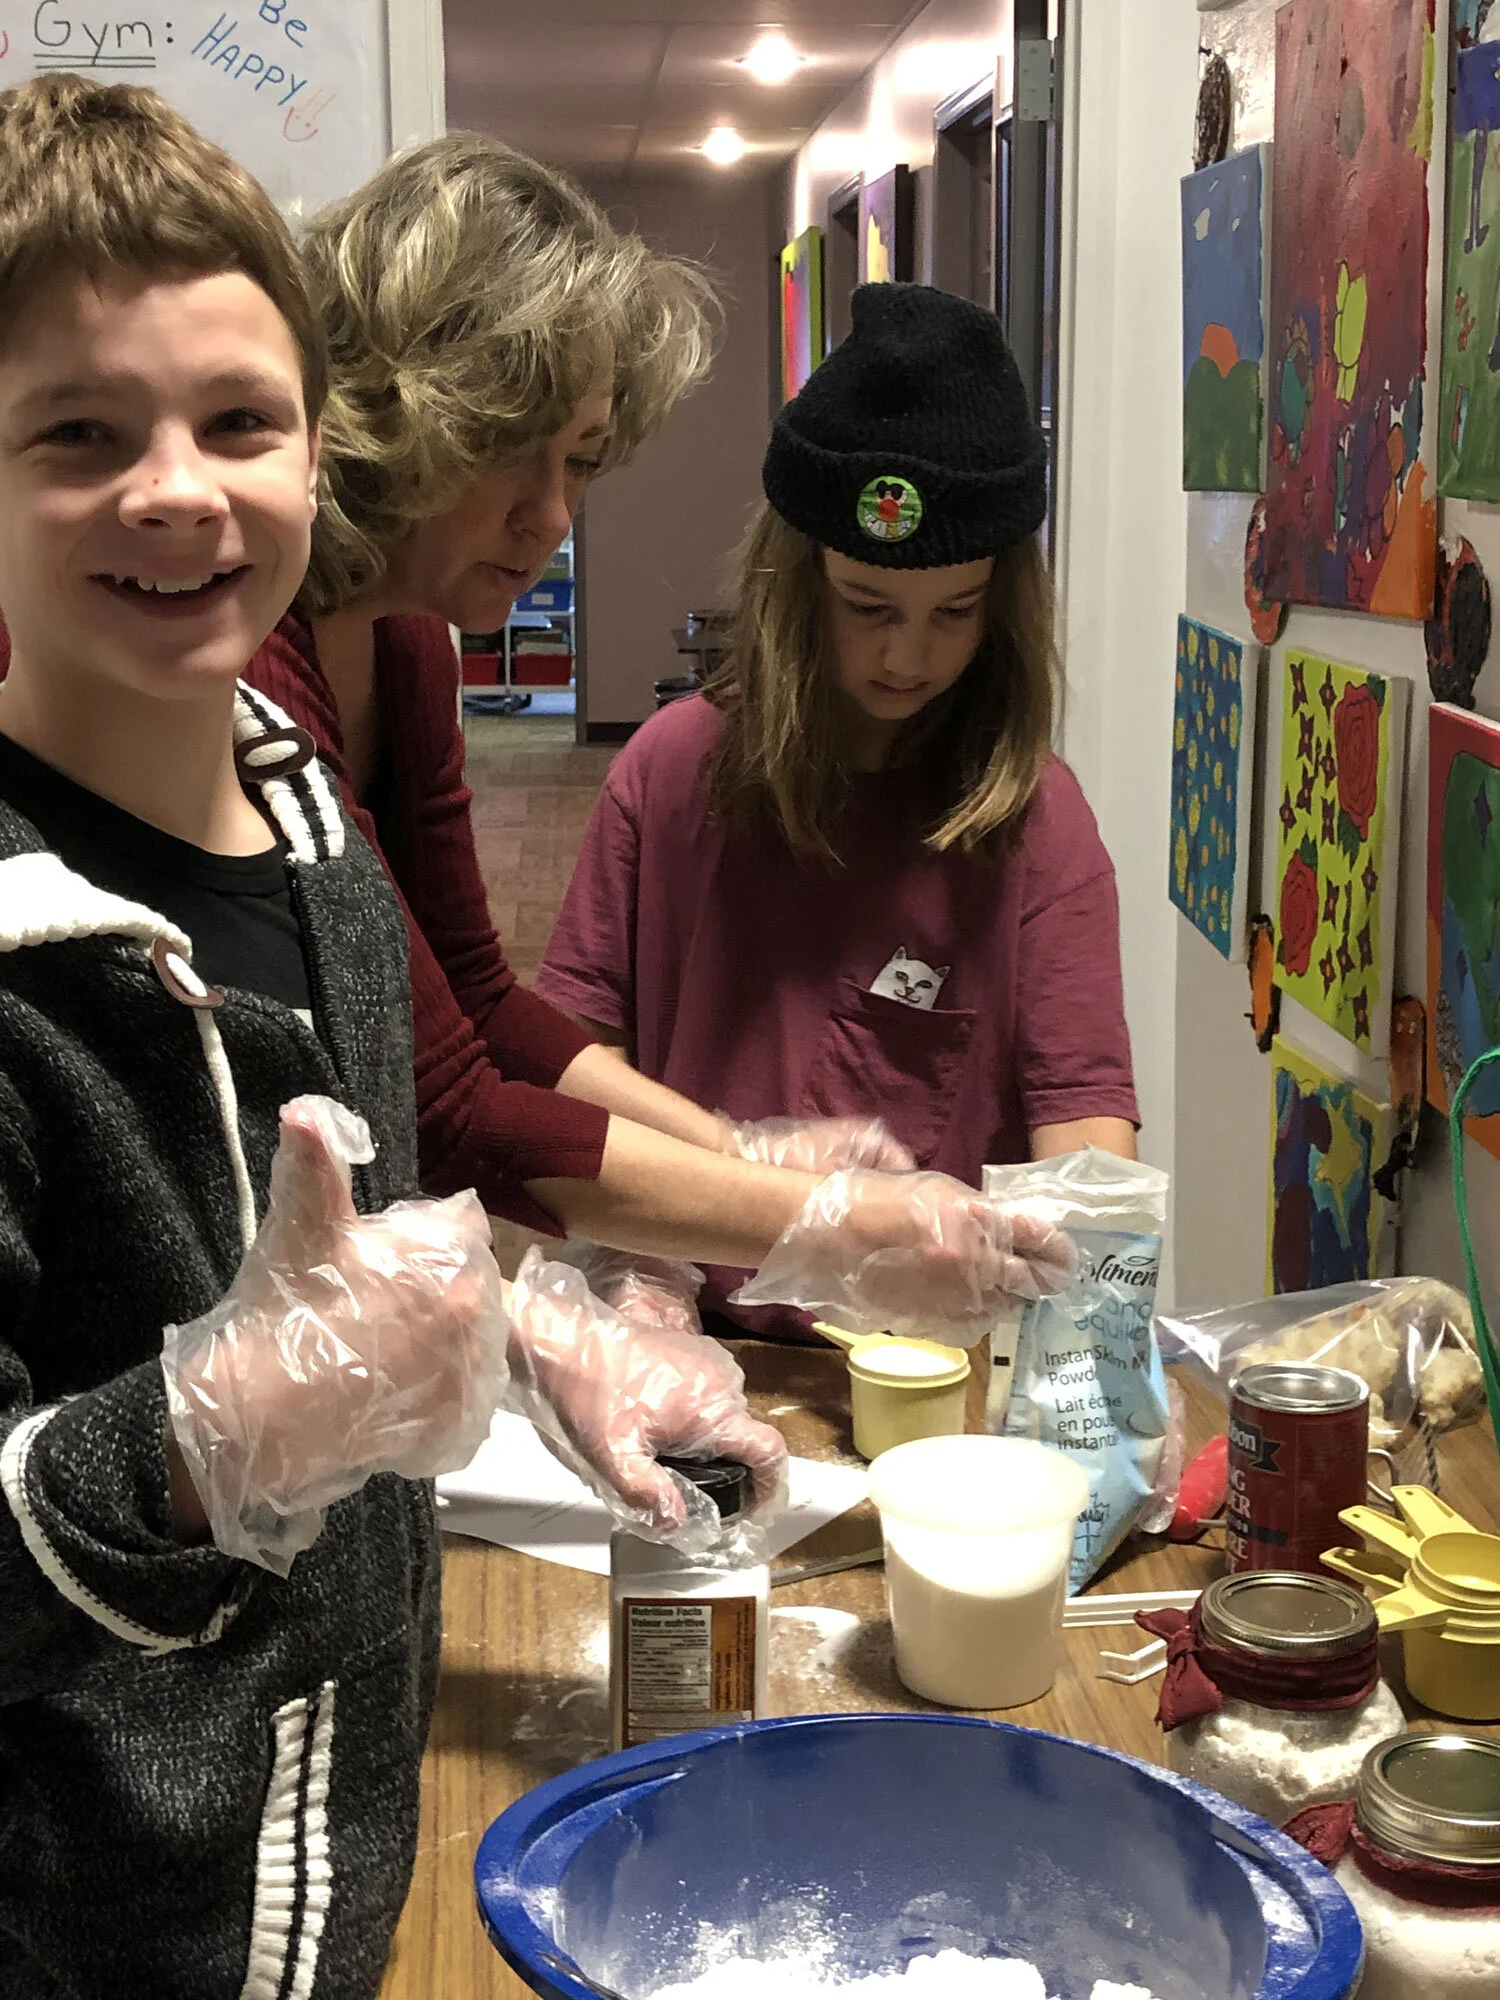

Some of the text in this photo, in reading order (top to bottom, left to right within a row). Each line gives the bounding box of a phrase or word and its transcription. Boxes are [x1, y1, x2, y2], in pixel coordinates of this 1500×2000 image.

[34, 0, 174, 66] Gym:
[191, 12, 309, 106] HAPPY
[1055, 1397, 1085, 1413] Lait
[1057, 1420, 1078, 1432] en
[677, 1606, 703, 1616] Facts
